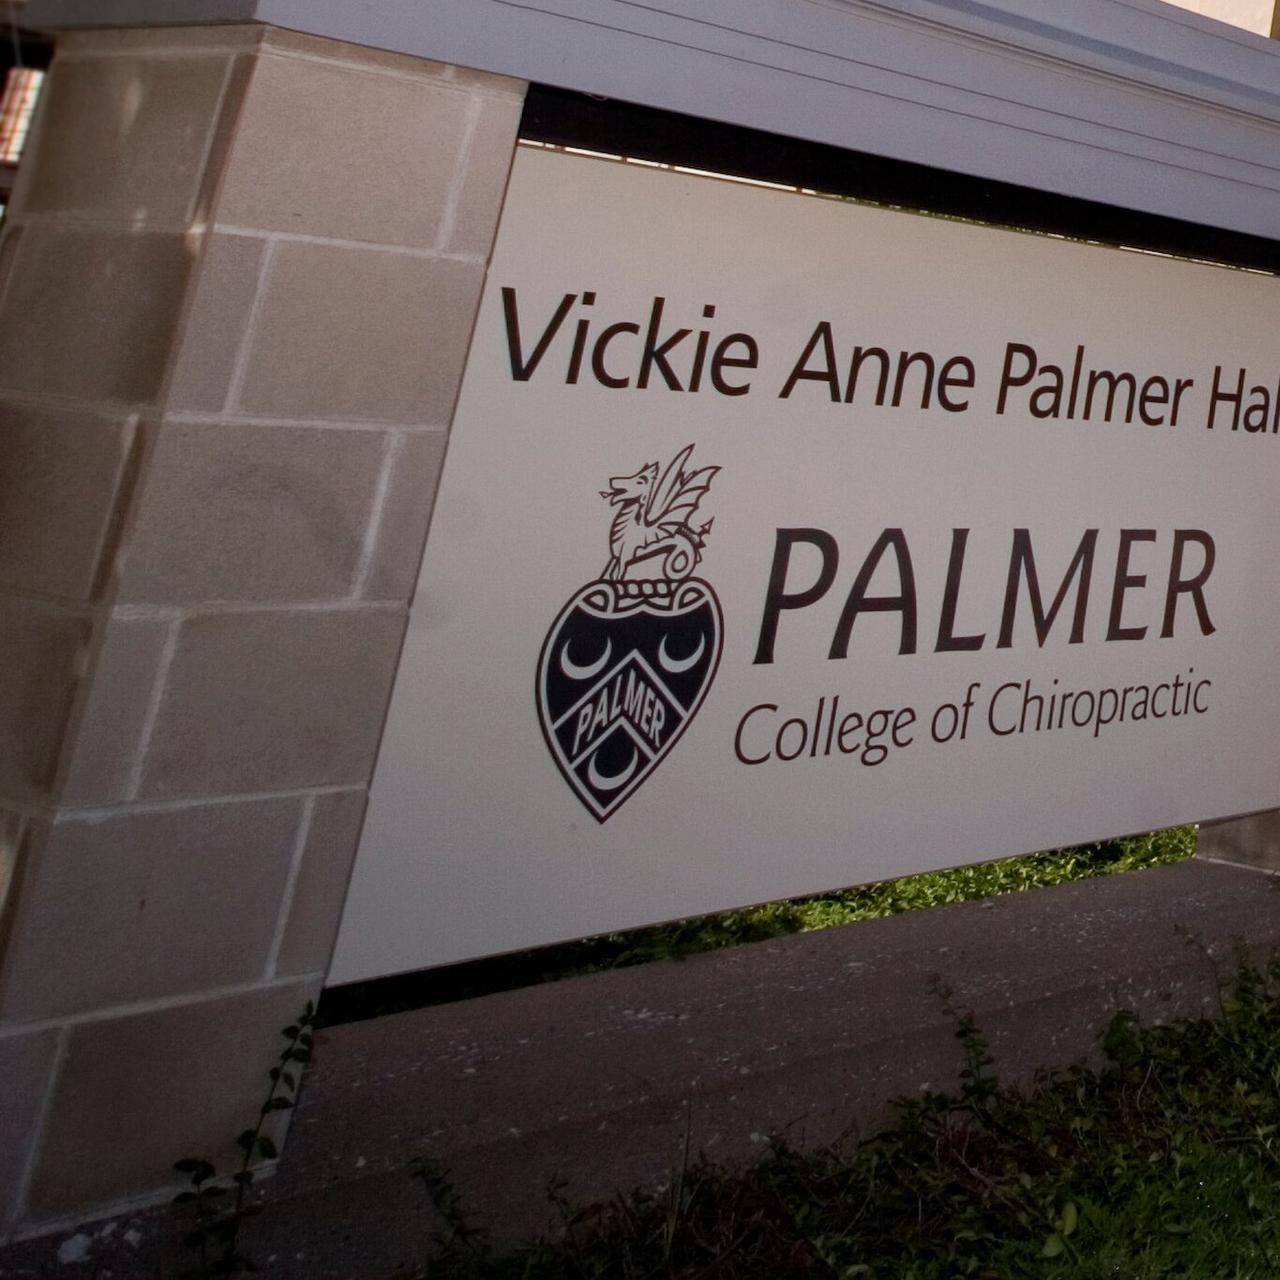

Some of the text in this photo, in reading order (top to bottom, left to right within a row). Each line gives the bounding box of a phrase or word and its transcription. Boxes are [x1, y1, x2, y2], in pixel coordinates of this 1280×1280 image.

[501, 286, 759, 398] Vickie
[778, 320, 976, 413] Anne
[995, 342, 1195, 427] Palmer
[751, 527, 1217, 666] PALMER
[572, 668, 666, 757] PALMER
[733, 668, 1212, 767] College of Chiropractic
